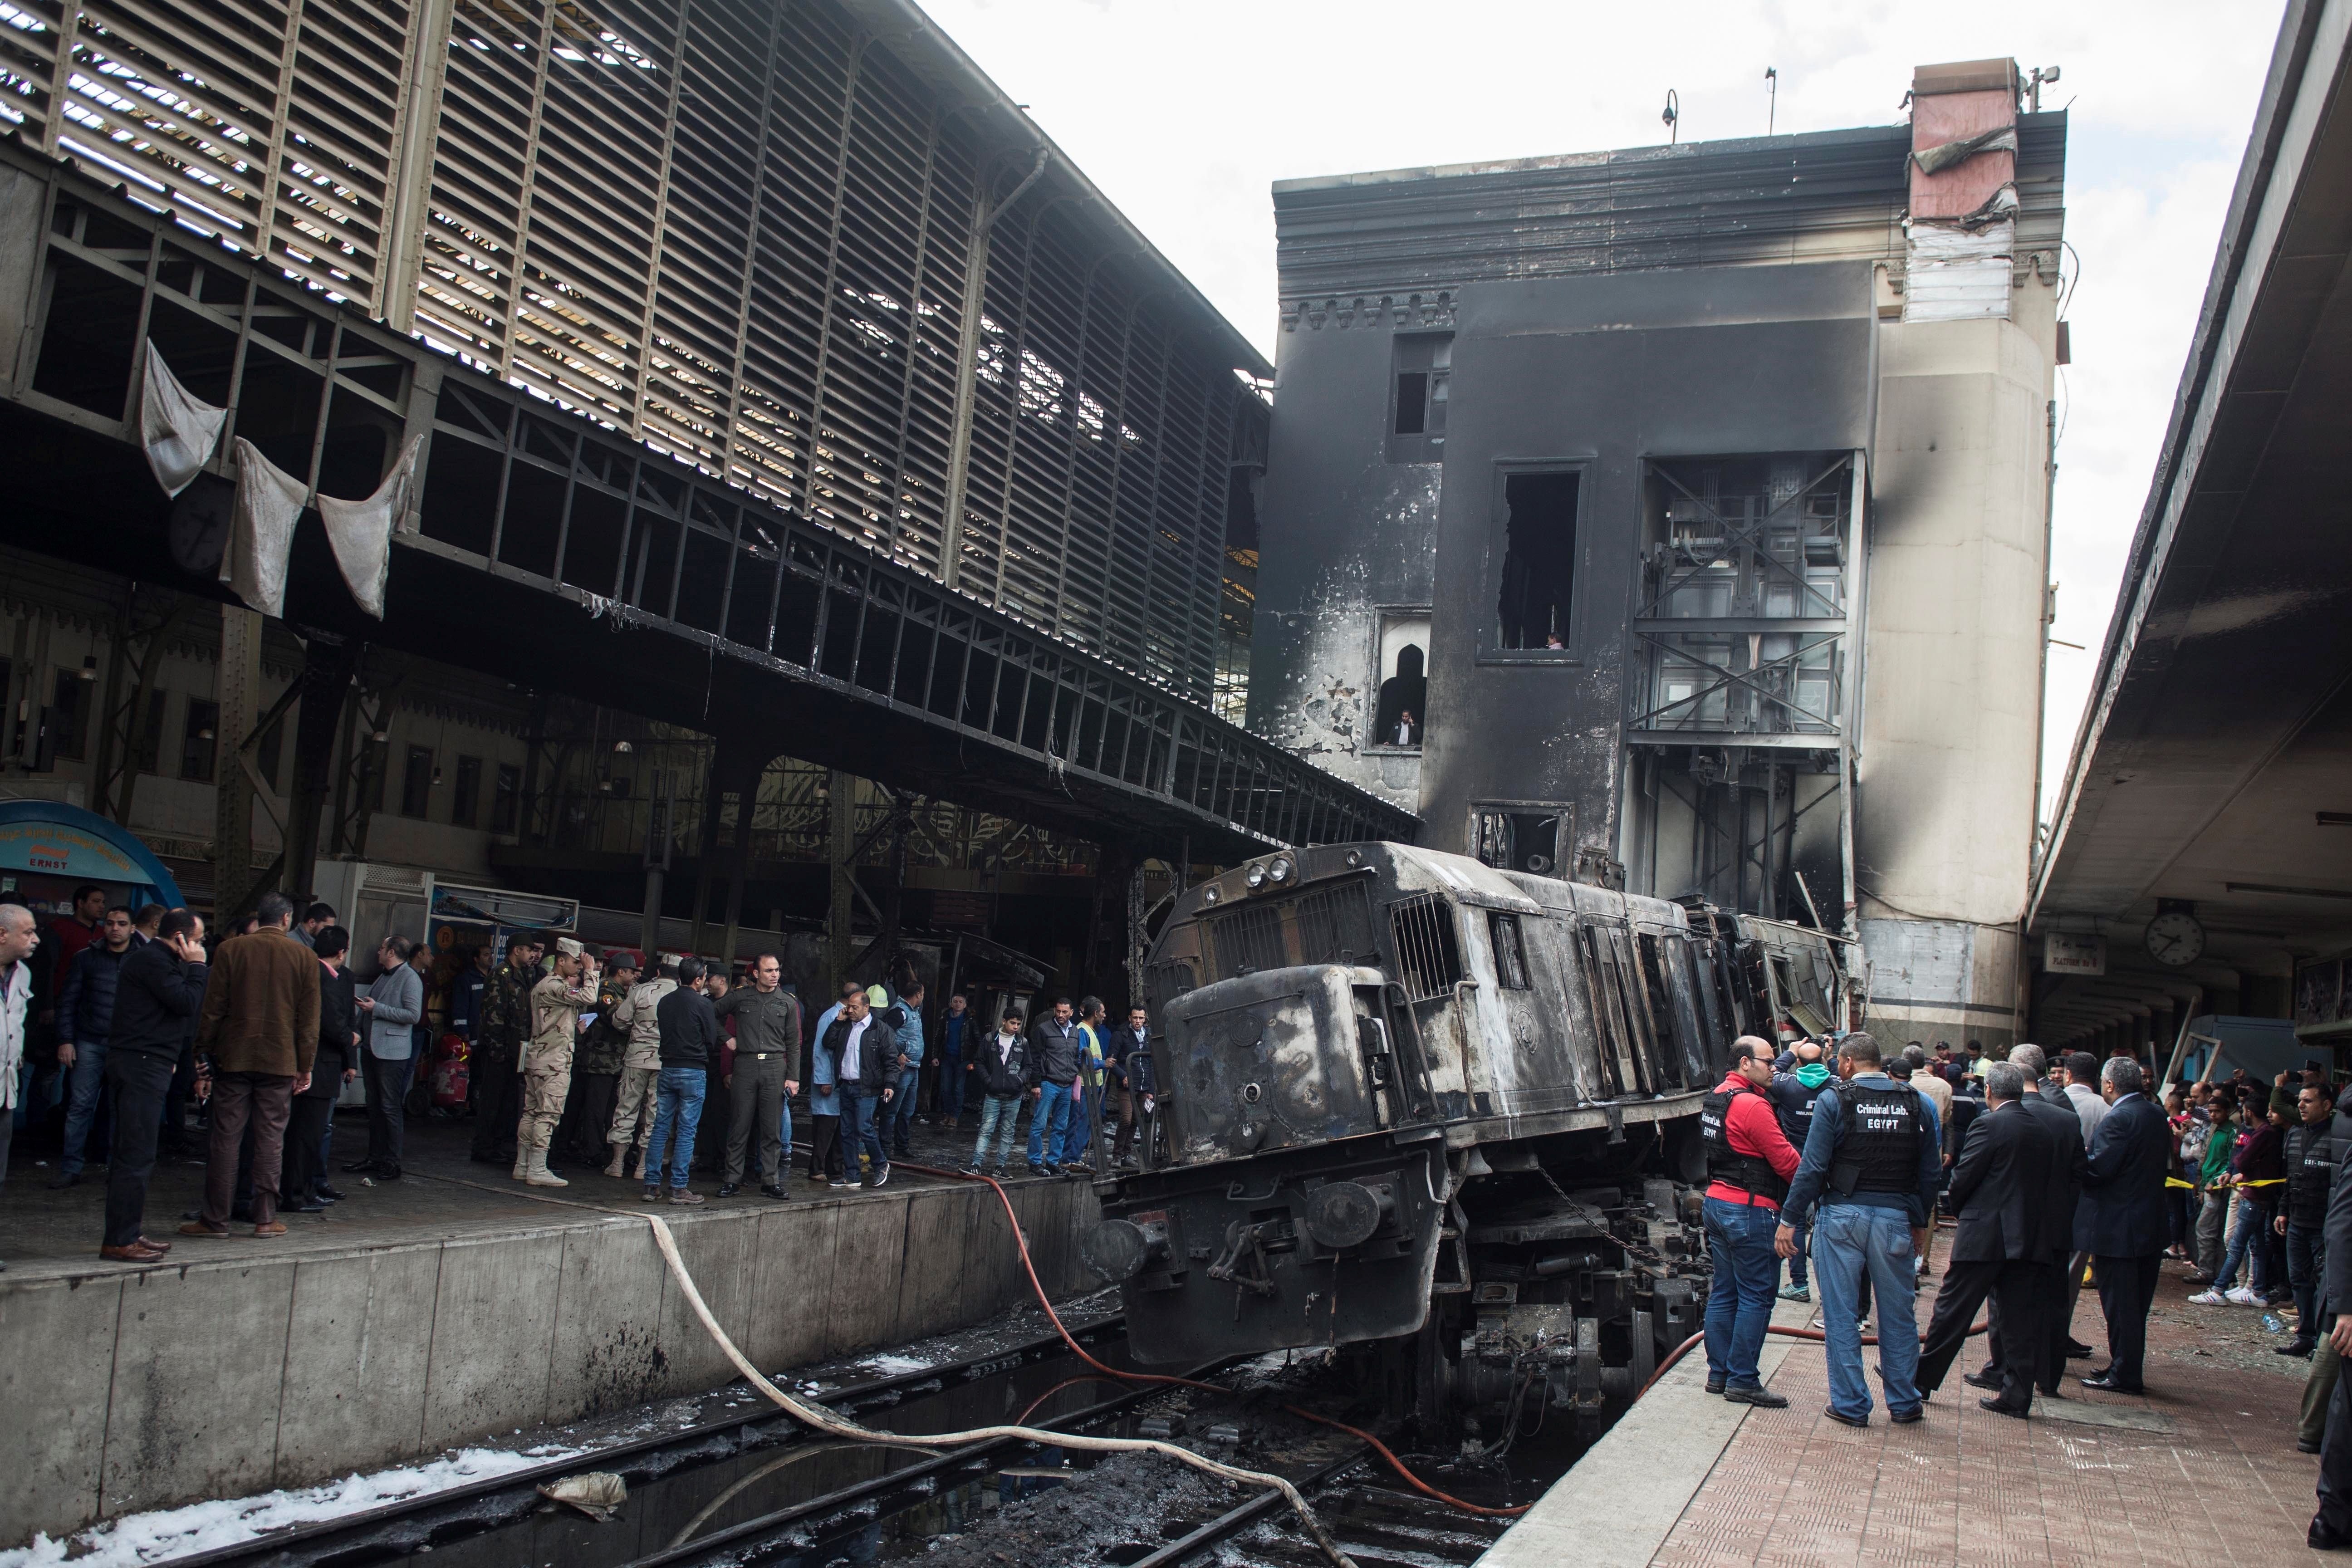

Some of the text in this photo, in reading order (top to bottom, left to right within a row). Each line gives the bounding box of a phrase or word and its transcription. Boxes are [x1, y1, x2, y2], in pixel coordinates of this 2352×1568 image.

[29, 858, 68, 870] ERNST
[2053, 957, 2080, 966] PLATFORM
[1857, 1103, 1909, 1115] Criminal Lab.
[1867, 1118, 1898, 1129] EGYPT
[1704, 1127, 1716, 1139] EGYPT
